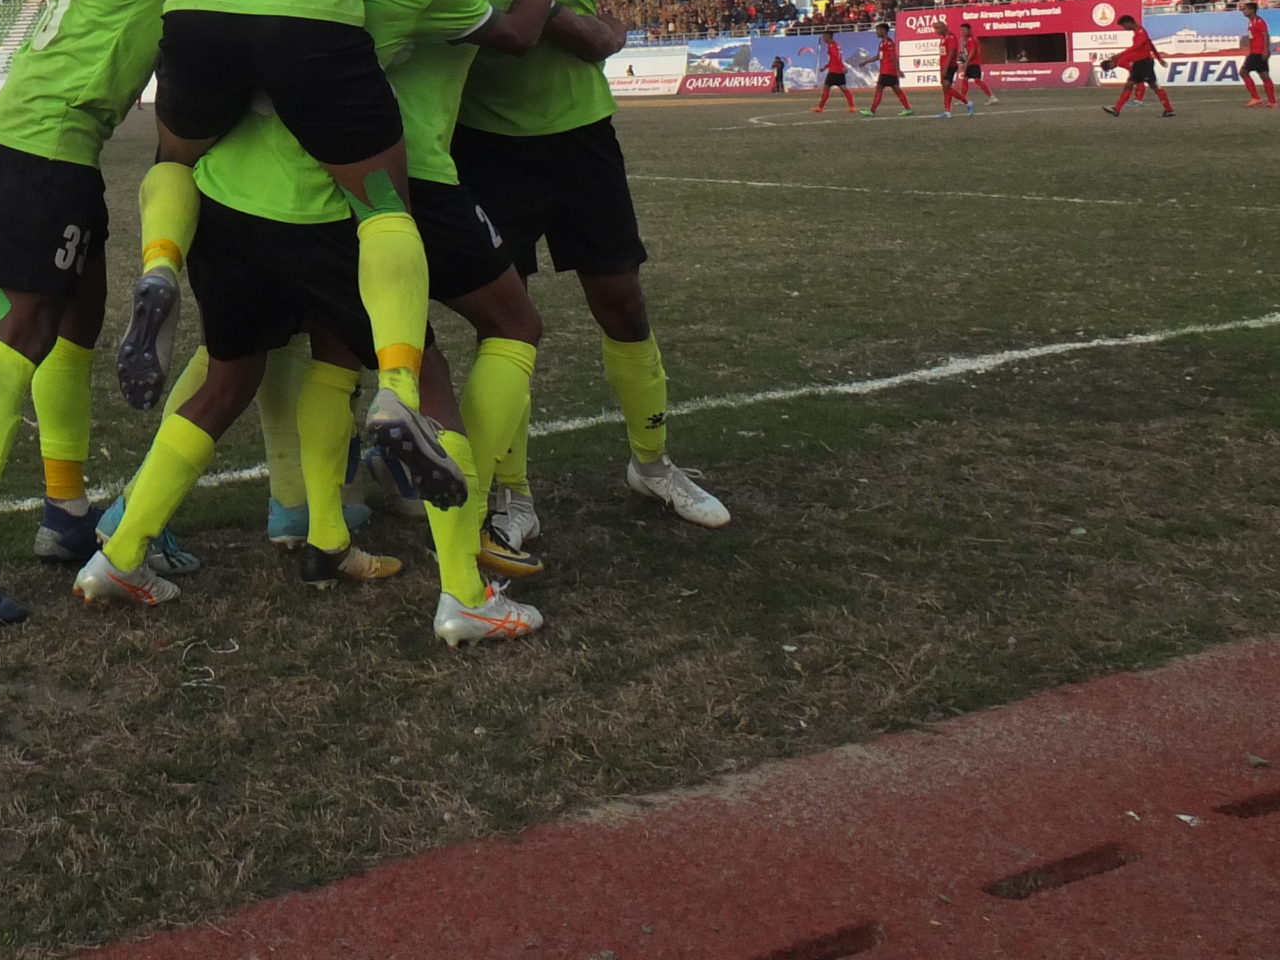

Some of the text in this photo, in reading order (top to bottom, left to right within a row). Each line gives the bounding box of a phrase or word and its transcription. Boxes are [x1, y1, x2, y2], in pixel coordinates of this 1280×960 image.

[906, 14, 947, 30] QATAR
[1090, 34, 1118, 42] QATAR
[1167, 60, 1241, 83] FIFA
[686, 75, 772, 89] QATAR AIRWAYS
[917, 75, 938, 83] FIFA
